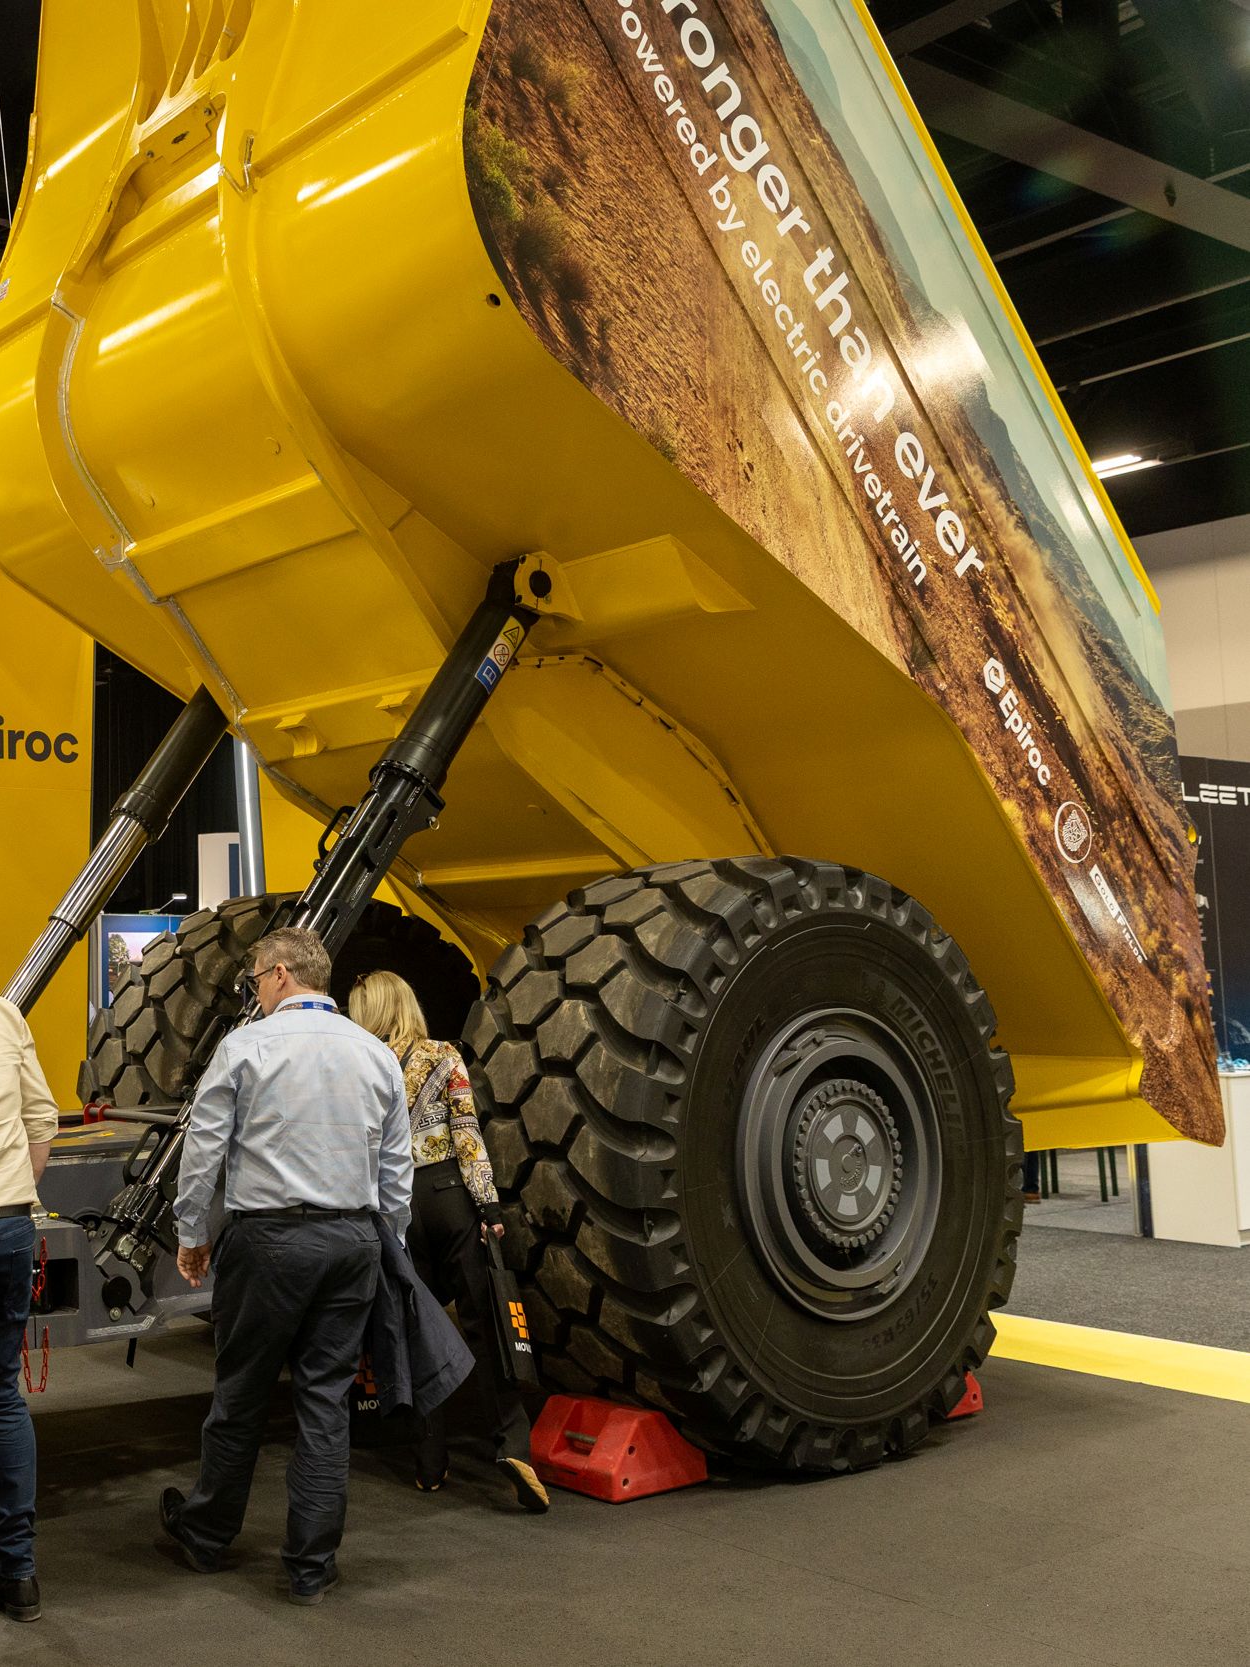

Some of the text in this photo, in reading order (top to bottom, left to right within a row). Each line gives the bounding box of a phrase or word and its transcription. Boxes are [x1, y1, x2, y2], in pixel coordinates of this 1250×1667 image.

[617, 0, 927, 586] owered by electric drivetrain
[803, 246, 896, 423] than
[894, 432, 985, 579] ever
[998, 688, 1052, 787] Epiroc
[1093, 871, 1117, 913] GOLD
[1116, 914, 1144, 965] FIELDS
